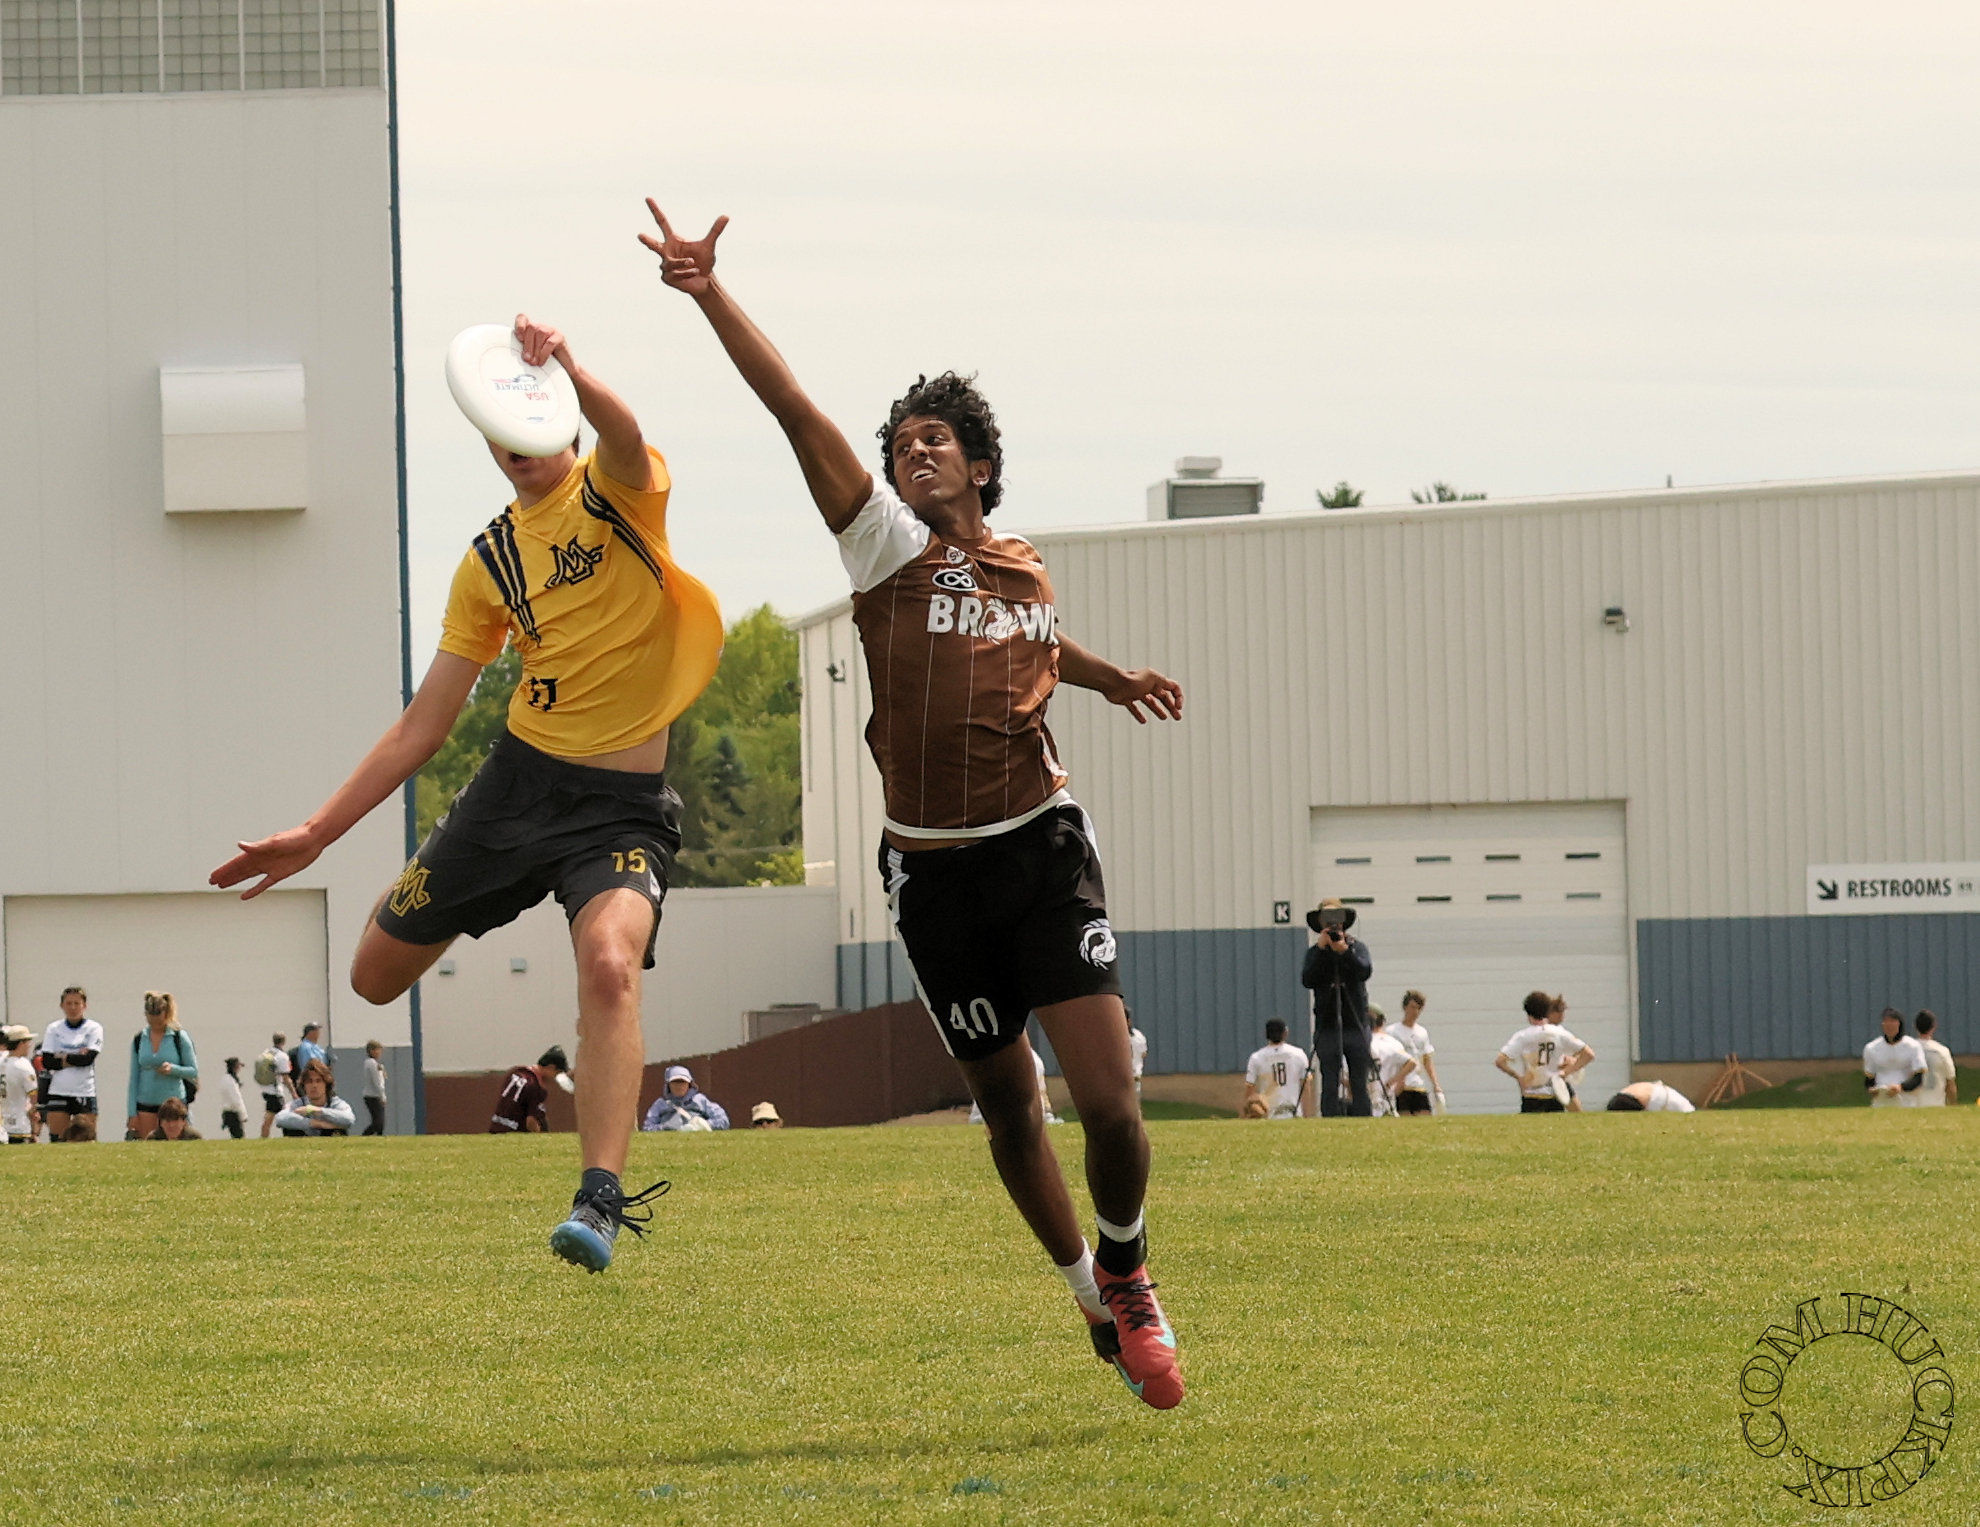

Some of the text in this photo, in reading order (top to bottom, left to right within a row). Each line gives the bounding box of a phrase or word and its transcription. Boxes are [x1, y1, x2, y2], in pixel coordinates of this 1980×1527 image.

[525, 391, 550, 401] USA
[1847, 878, 1953, 899] RESTROOMS
[1275, 903, 1289, 921] K
[949, 997, 999, 1040] 40
